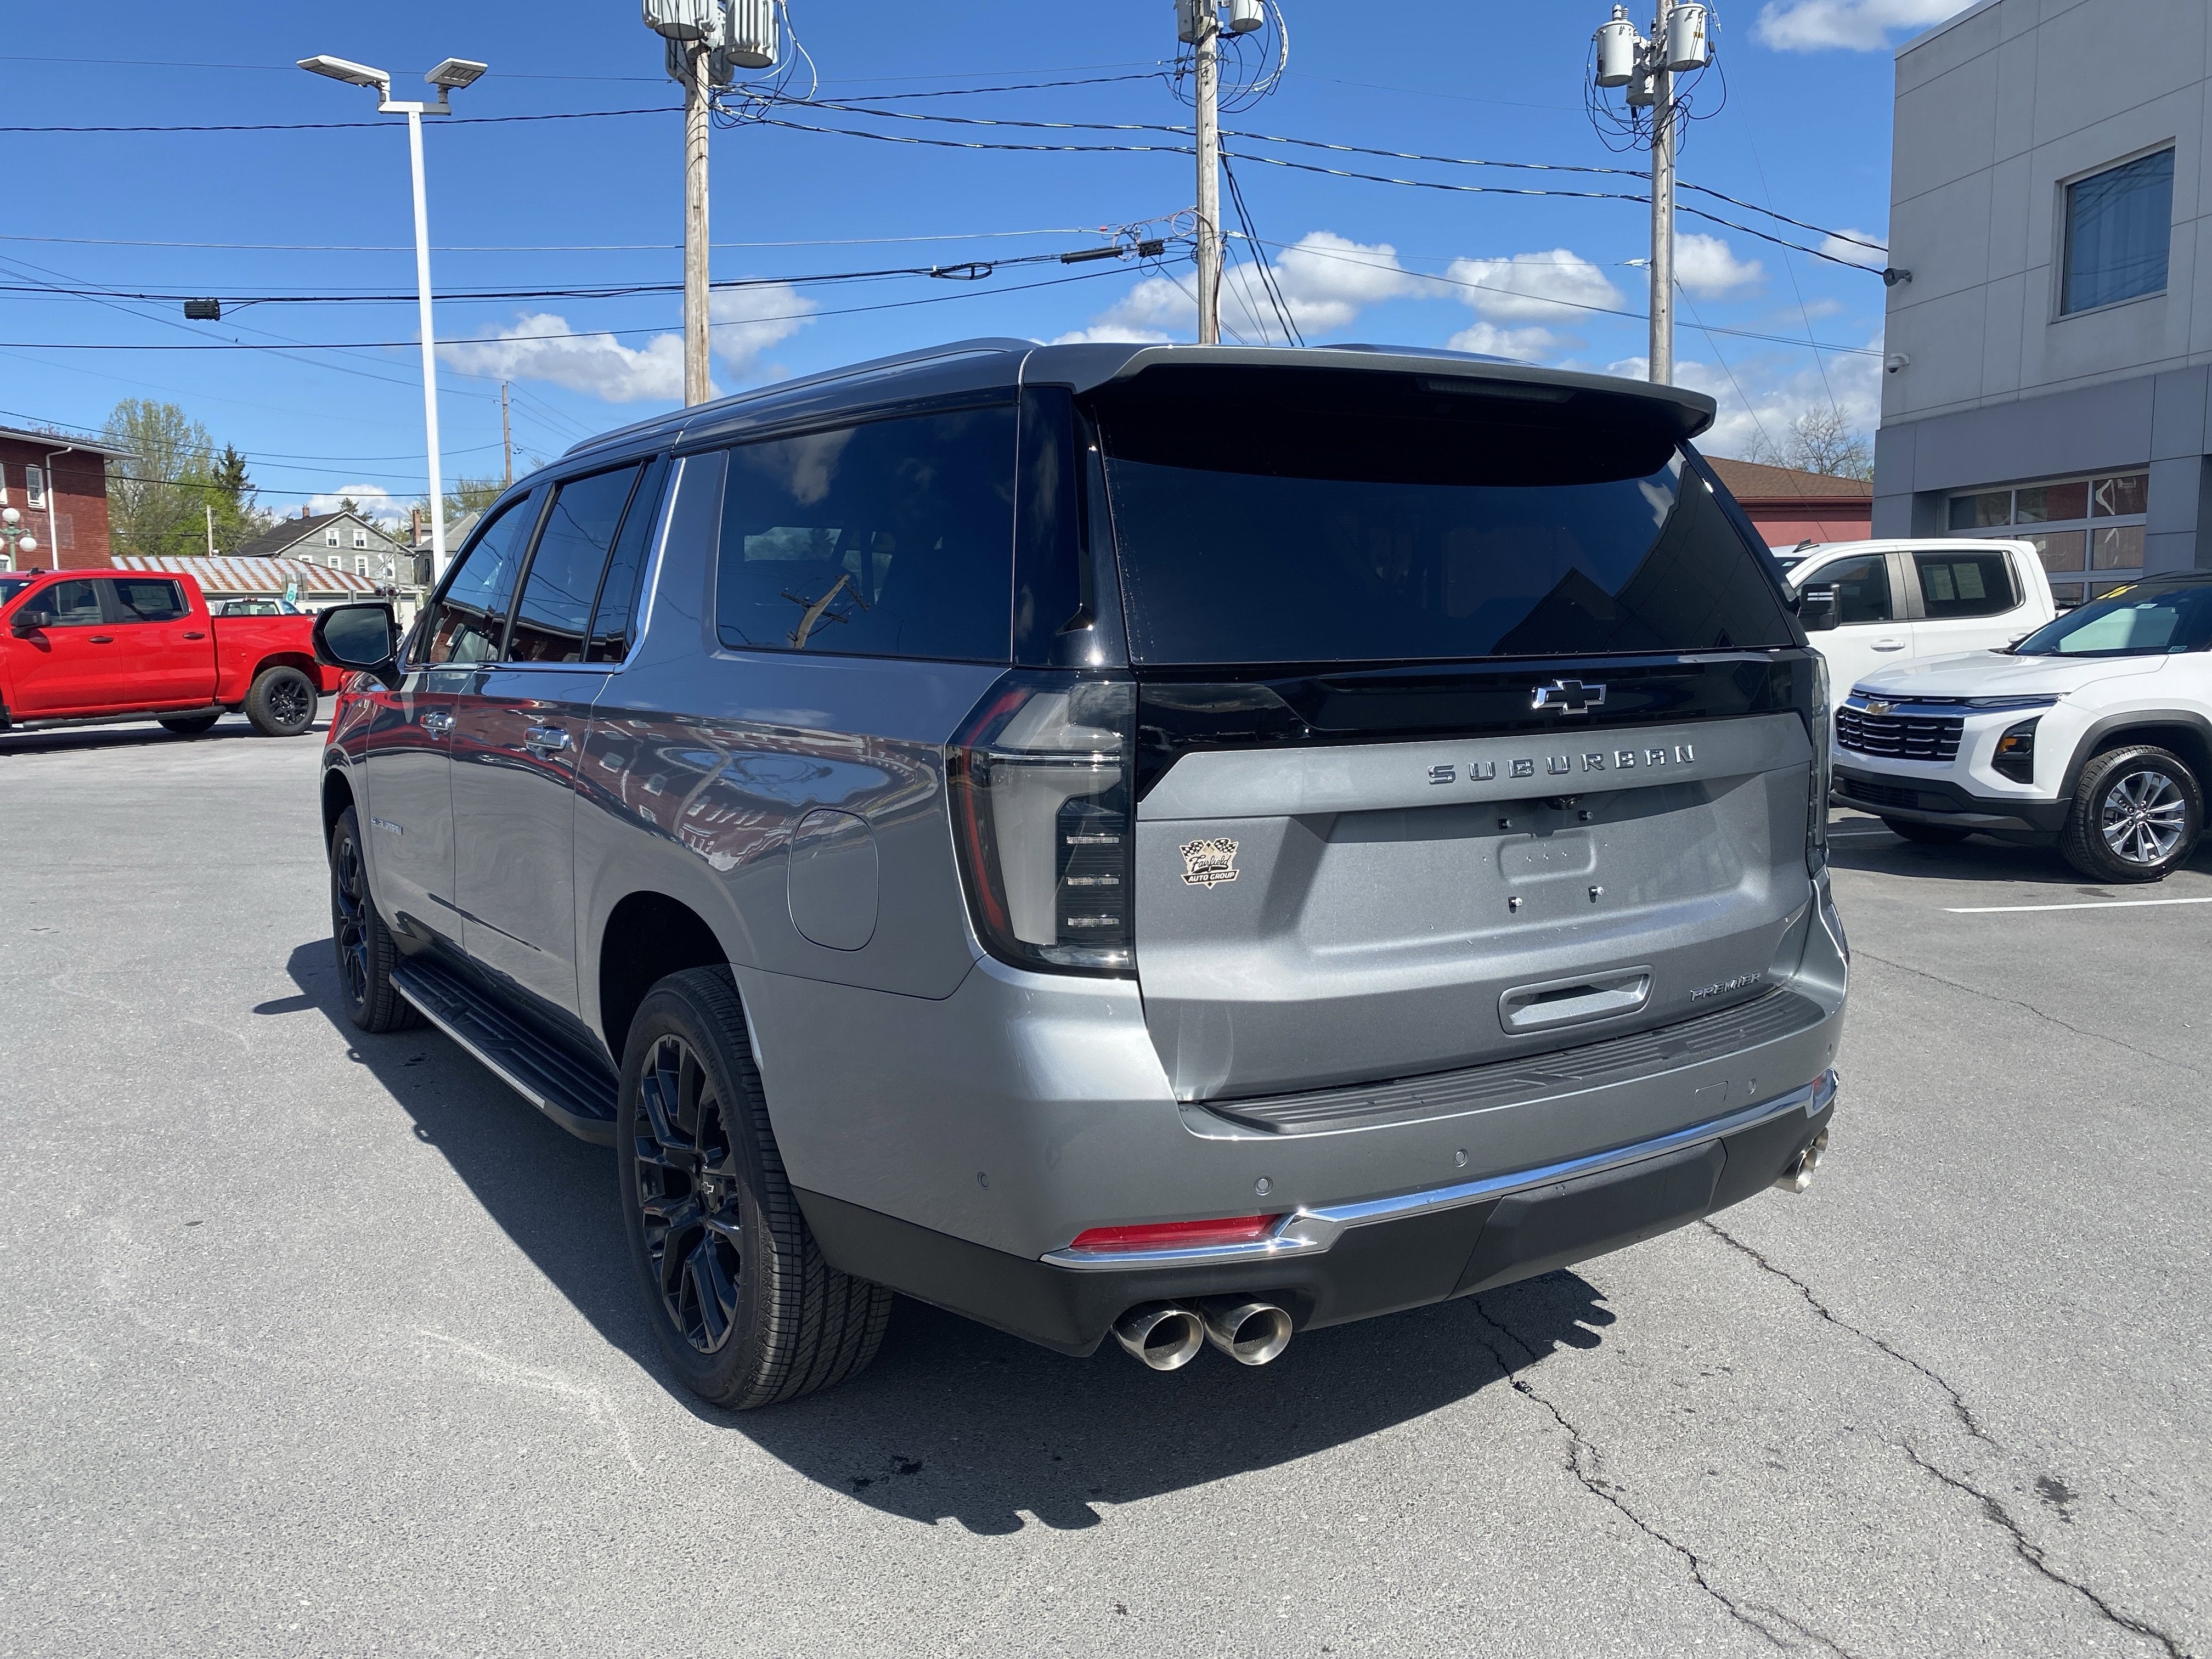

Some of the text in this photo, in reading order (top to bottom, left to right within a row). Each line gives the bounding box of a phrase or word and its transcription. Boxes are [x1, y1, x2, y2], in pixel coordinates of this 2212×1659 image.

[1427, 743, 1695, 784] SUBURBAN
[1189, 854, 1231, 872] Fairfield
[1690, 972, 1761, 1002] PREMIER
